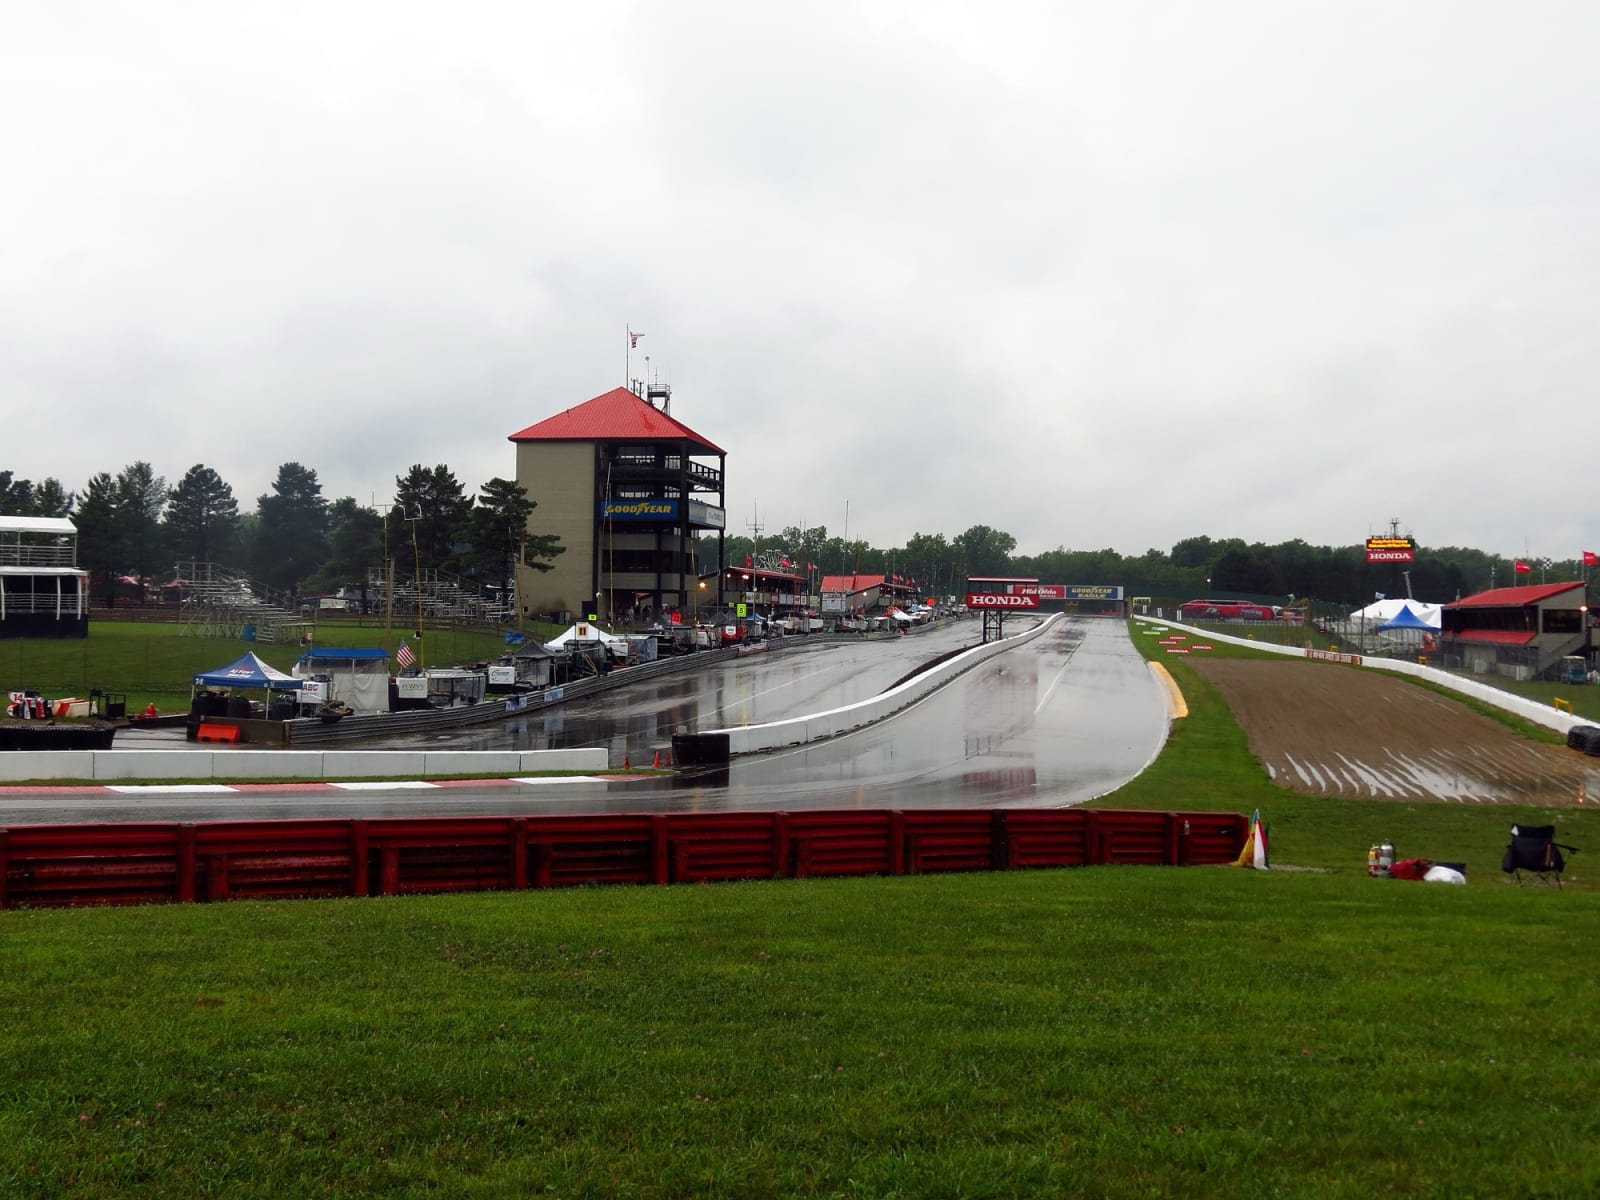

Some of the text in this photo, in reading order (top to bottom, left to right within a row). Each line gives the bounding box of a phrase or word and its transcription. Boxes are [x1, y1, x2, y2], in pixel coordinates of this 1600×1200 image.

[606, 502, 672, 515] GOODYEAR
[971, 595, 1035, 605] HONDA
[302, 683, 319, 692] ABC
[13, 693, 23, 702] 14
